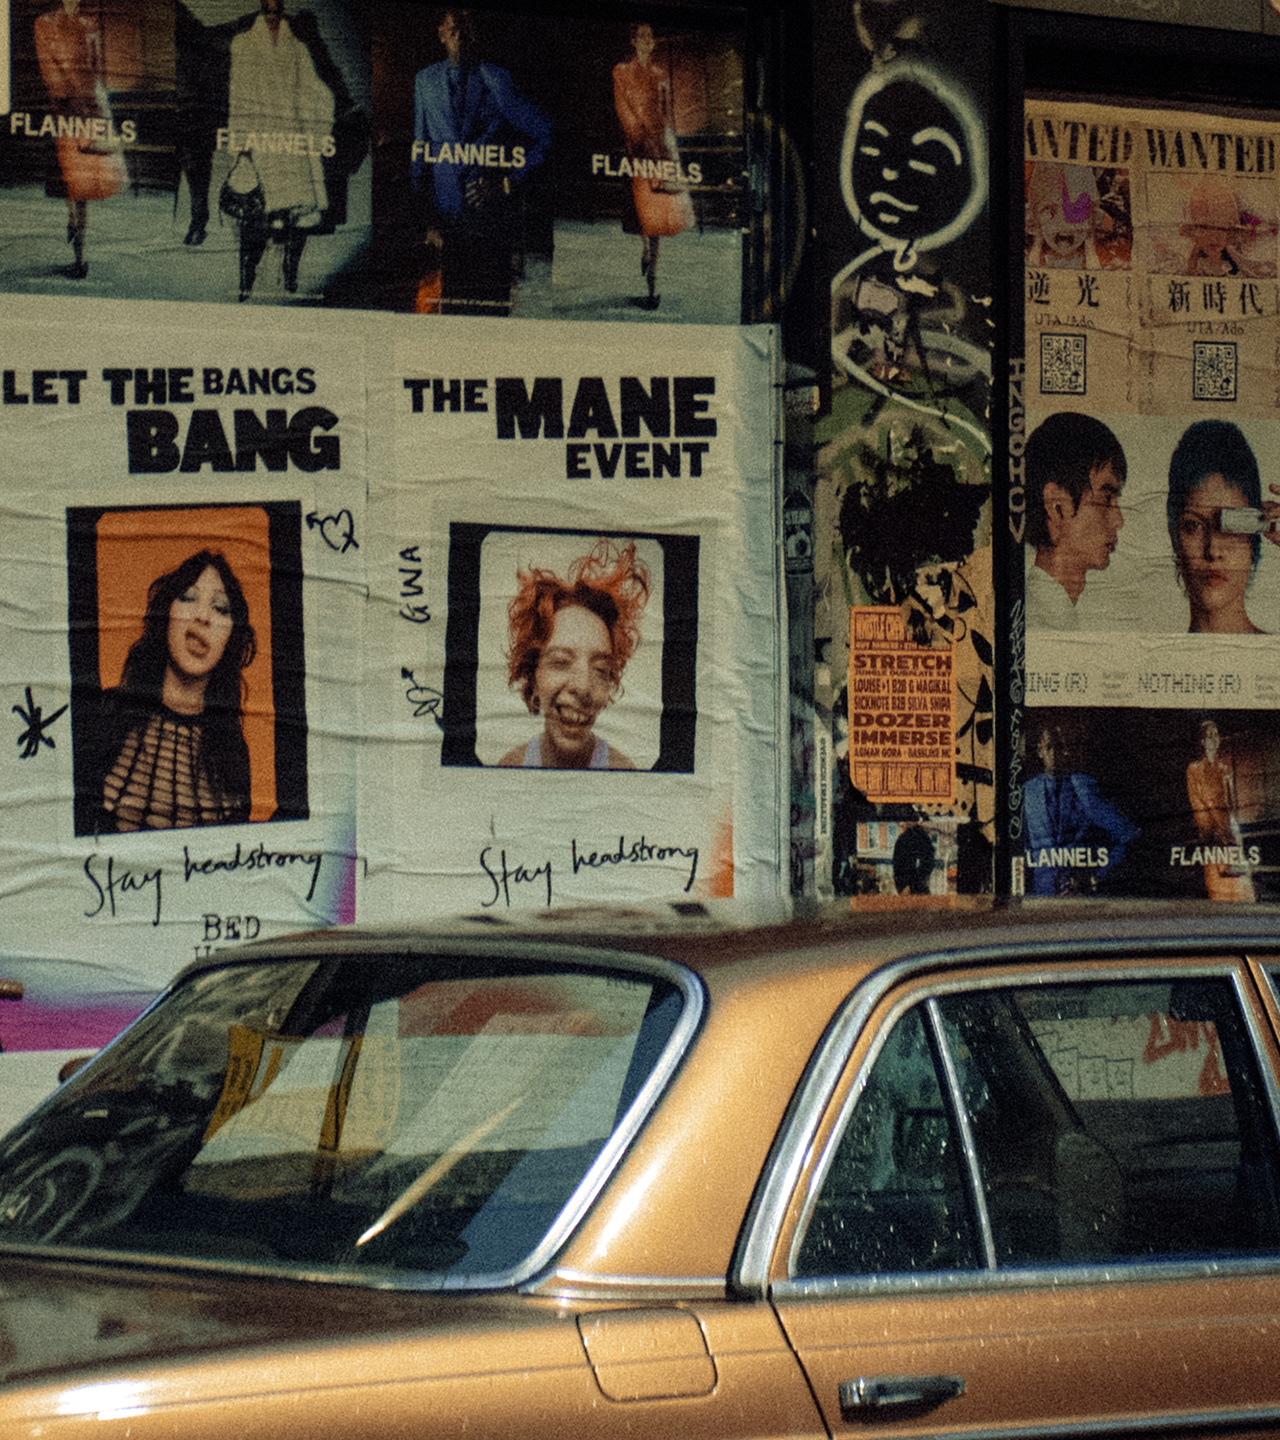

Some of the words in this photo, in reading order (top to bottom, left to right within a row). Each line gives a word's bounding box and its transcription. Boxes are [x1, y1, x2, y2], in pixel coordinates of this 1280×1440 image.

[10, 112, 138, 145] FLANNELS
[214, 125, 338, 160] FLANNELS
[1024, 118, 1134, 164] ANTED
[410, 140, 528, 171] FLANNELS
[1145, 127, 1276, 174] WANTED
[591, 152, 704, 185] FLANNELS
[1166, 279, 1265, 317] 新時代
[2, 369, 88, 405] LET
[102, 367, 196, 406] THE
[202, 366, 318, 397] BANGS
[402, 377, 489, 414] THE
[494, 376, 718, 440] MANE
[125, 404, 342, 476] BANG
[565, 441, 711, 481] EVENT
[853, 654, 952, 670] STRETCH
[891, 678, 907, 694] B2B
[891, 695, 906, 711] B2B
[853, 712, 952, 728] DOZER
[853, 730, 952, 746] IMMERSE
[479, 845, 553, 908] Stay
[570, 835, 700, 894] headstrong
[1025, 846, 1110, 868] LANNELS
[1169, 845, 1261, 867] FLANNELS
[83, 852, 163, 928] Stay
[183, 842, 323, 902] headstrong
[201, 913, 262, 943] BED
